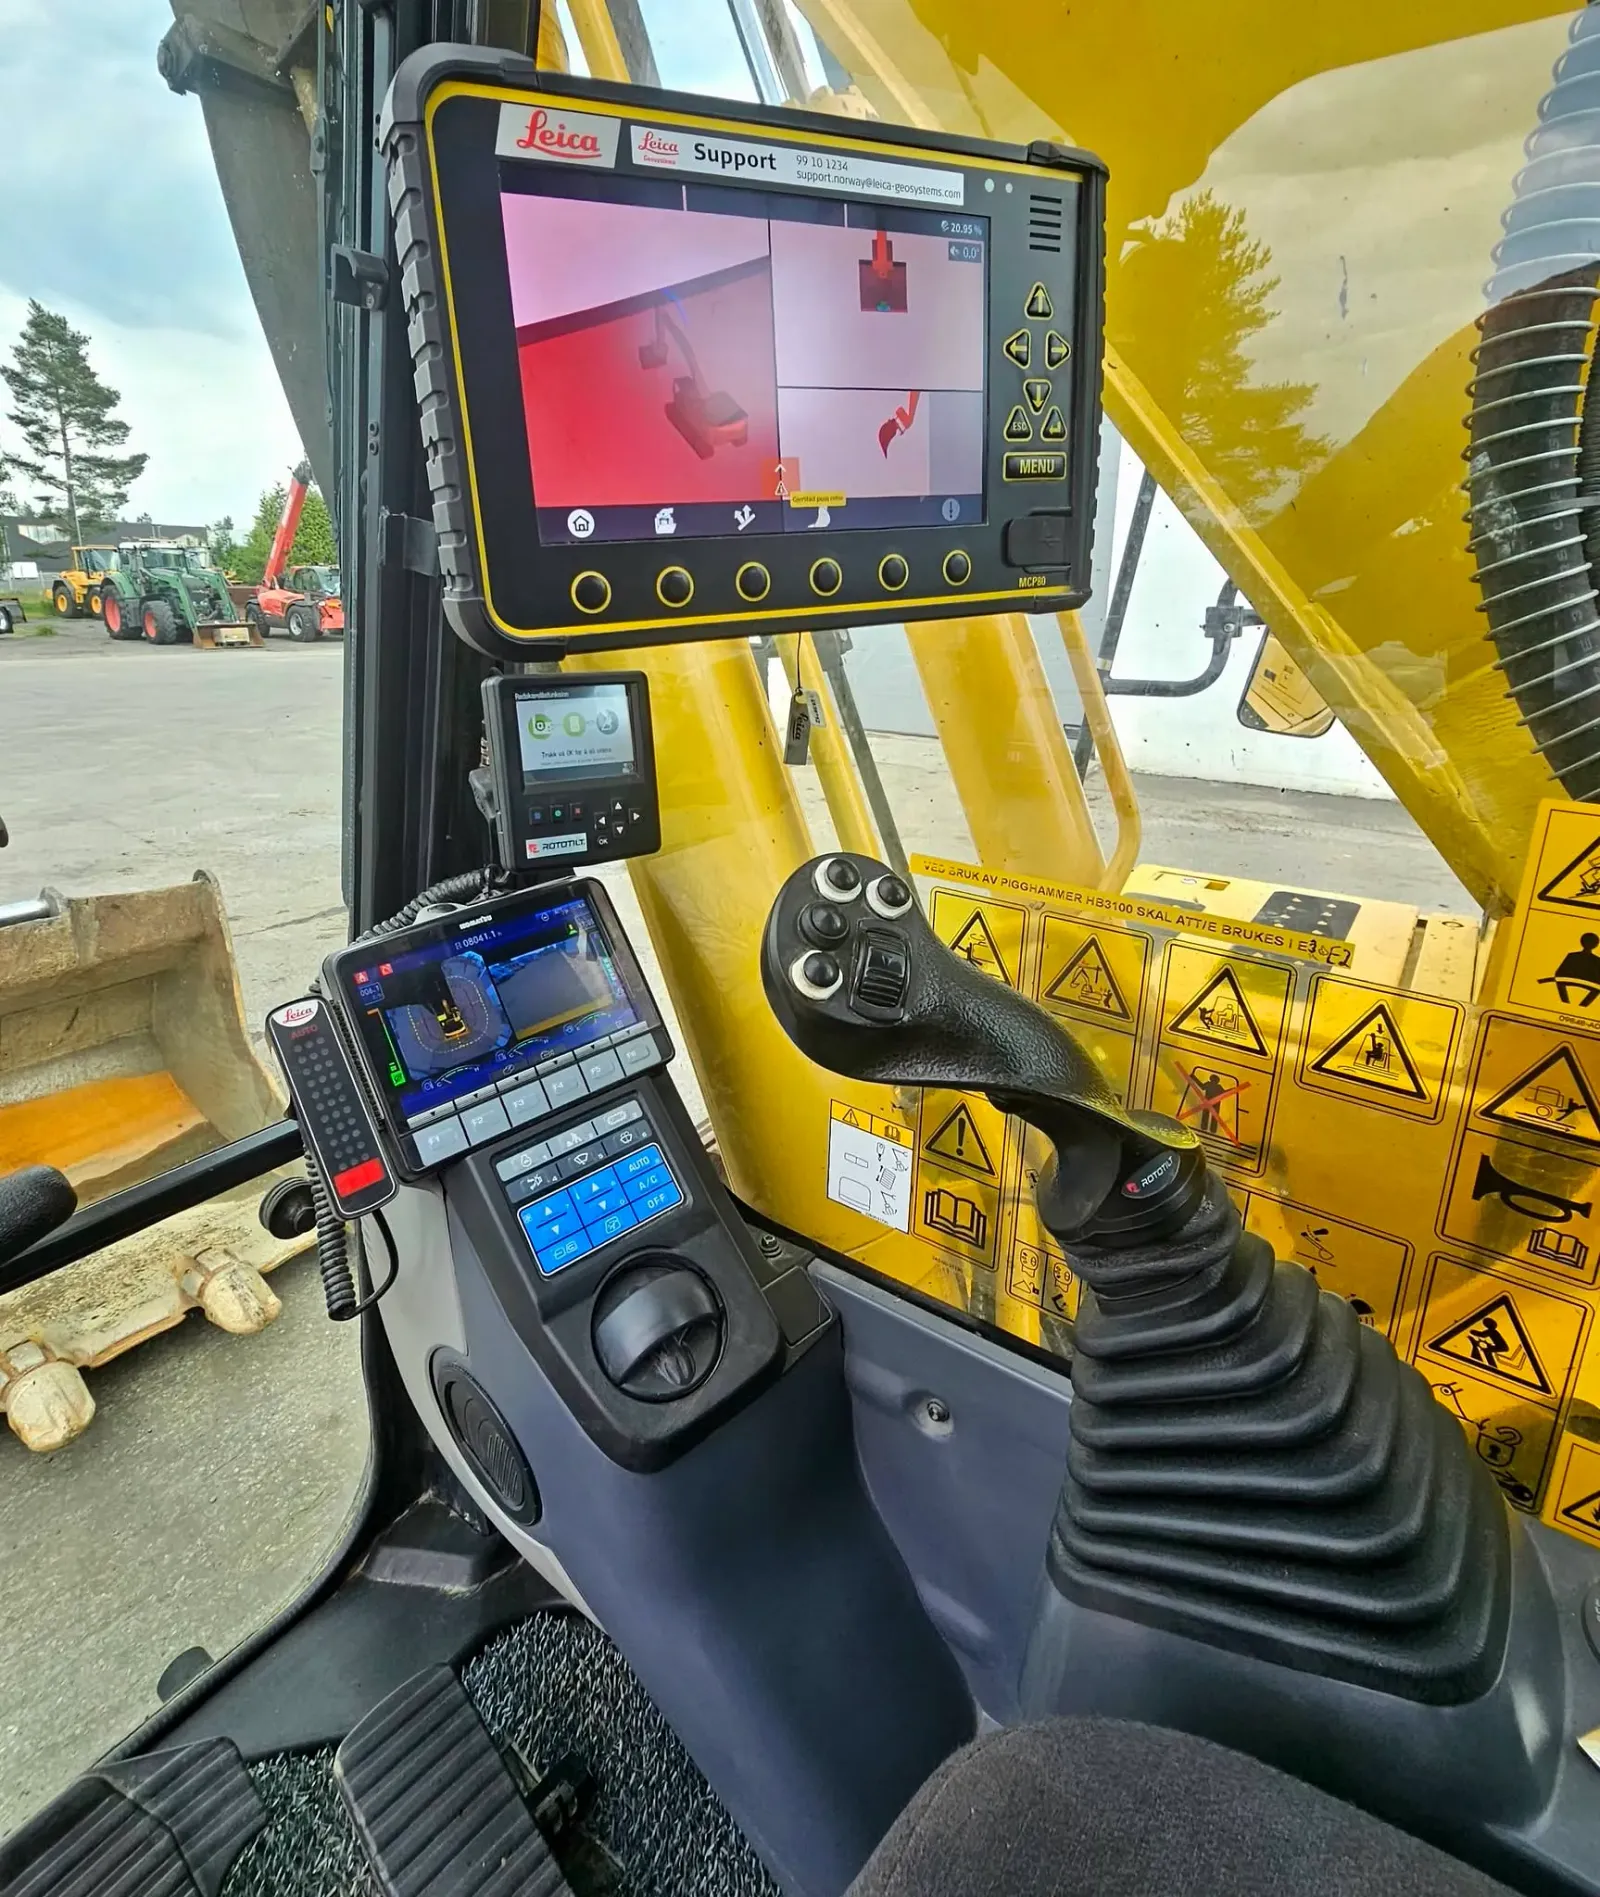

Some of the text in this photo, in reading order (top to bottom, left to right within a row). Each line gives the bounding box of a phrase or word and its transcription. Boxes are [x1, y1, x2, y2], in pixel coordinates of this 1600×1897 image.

[517, 109, 602, 159] Leica
[638, 131, 679, 156] Leica
[694, 143, 777, 171] Support
[796, 154, 848, 172] 99 10 1234
[1012, 421, 1027, 431] ESC
[1019, 459, 1055, 474] MENU
[1018, 576, 1046, 588] MCP80
[598, 837, 608, 845] OK
[948, 867, 980, 882] BRUK
[981, 874, 998, 885] AV
[1000, 877, 1083, 905] PIGGHAMMER
[1086, 895, 1133, 914] HB3100
[1136, 906, 1172, 923] SKAL
[1221, 924, 1284, 947] BRUKES
[462, 930, 497, 948] 08041.1
[283, 1007, 314, 1024] Leica
[628, 1156, 650, 1173] AUTO
[639, 1174, 658, 1191] A/C
[646, 1193, 666, 1209] OFF
